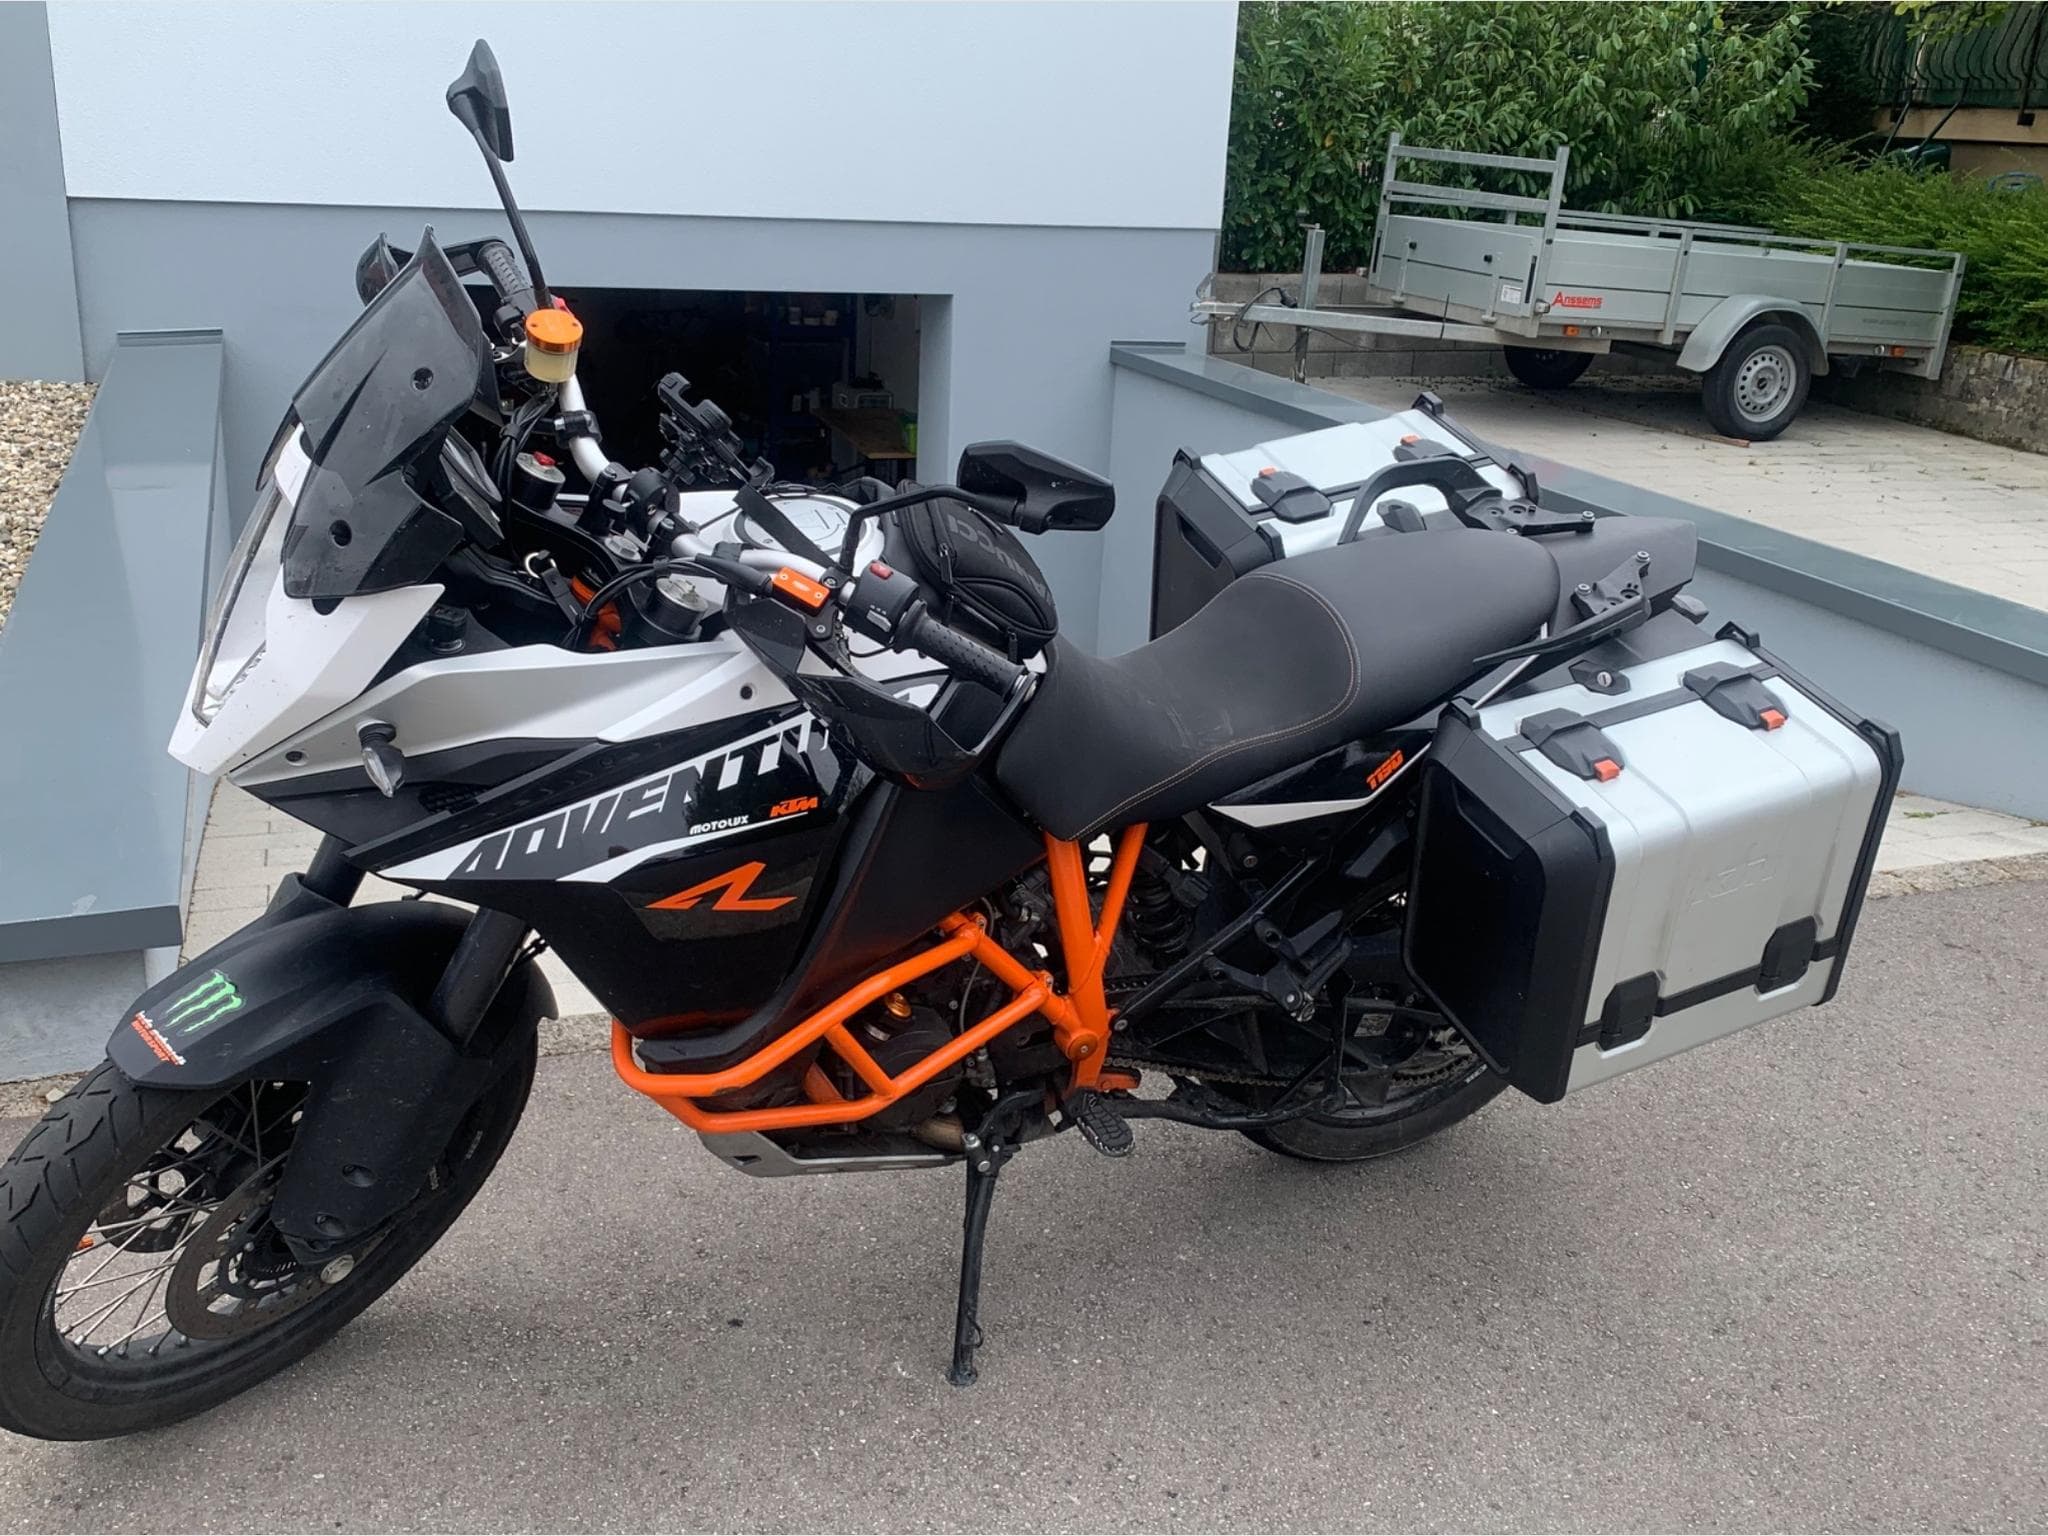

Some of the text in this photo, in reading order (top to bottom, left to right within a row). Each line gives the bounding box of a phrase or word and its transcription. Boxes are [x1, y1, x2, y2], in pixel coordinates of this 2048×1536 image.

[1552, 291, 1603, 308] Anssems
[770, 796, 818, 818] KTM
[689, 815, 750, 836] MOTOLUX
